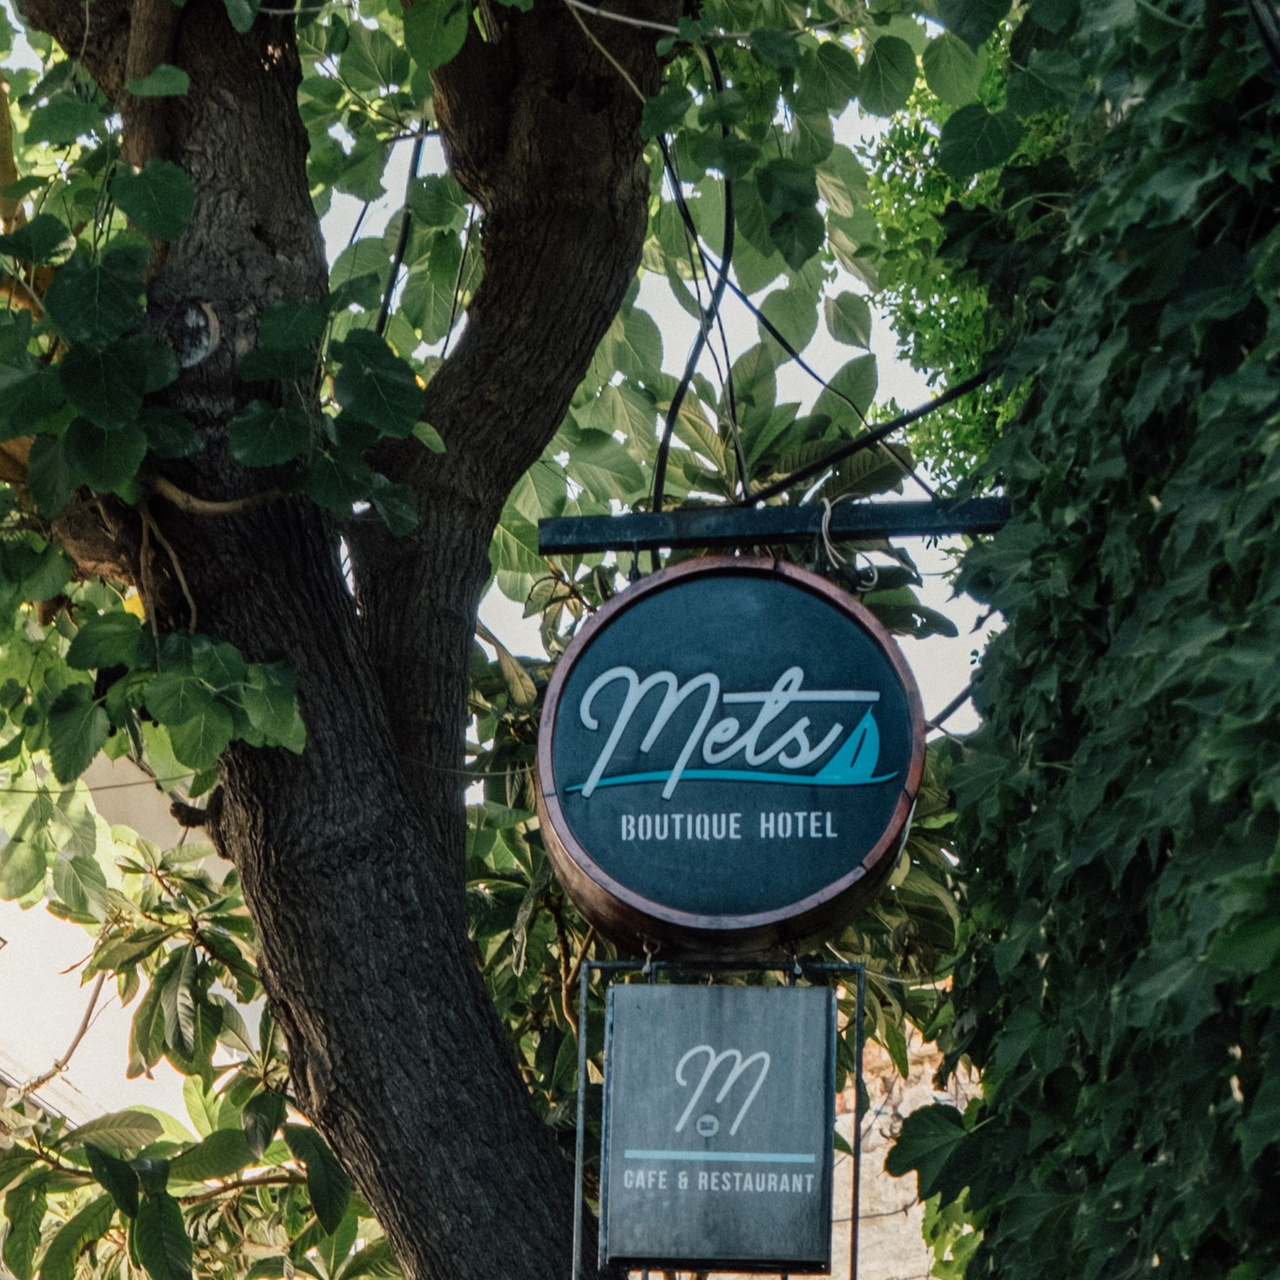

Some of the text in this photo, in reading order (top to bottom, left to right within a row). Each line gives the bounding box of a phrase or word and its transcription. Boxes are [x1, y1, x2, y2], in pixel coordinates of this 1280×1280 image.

[580, 666, 880, 800] Mets
[621, 812, 838, 841] BOUTIQUE HOTEL
[675, 1044, 771, 1136] M
[624, 1169, 815, 1193] CAFE & RESTAURANT
